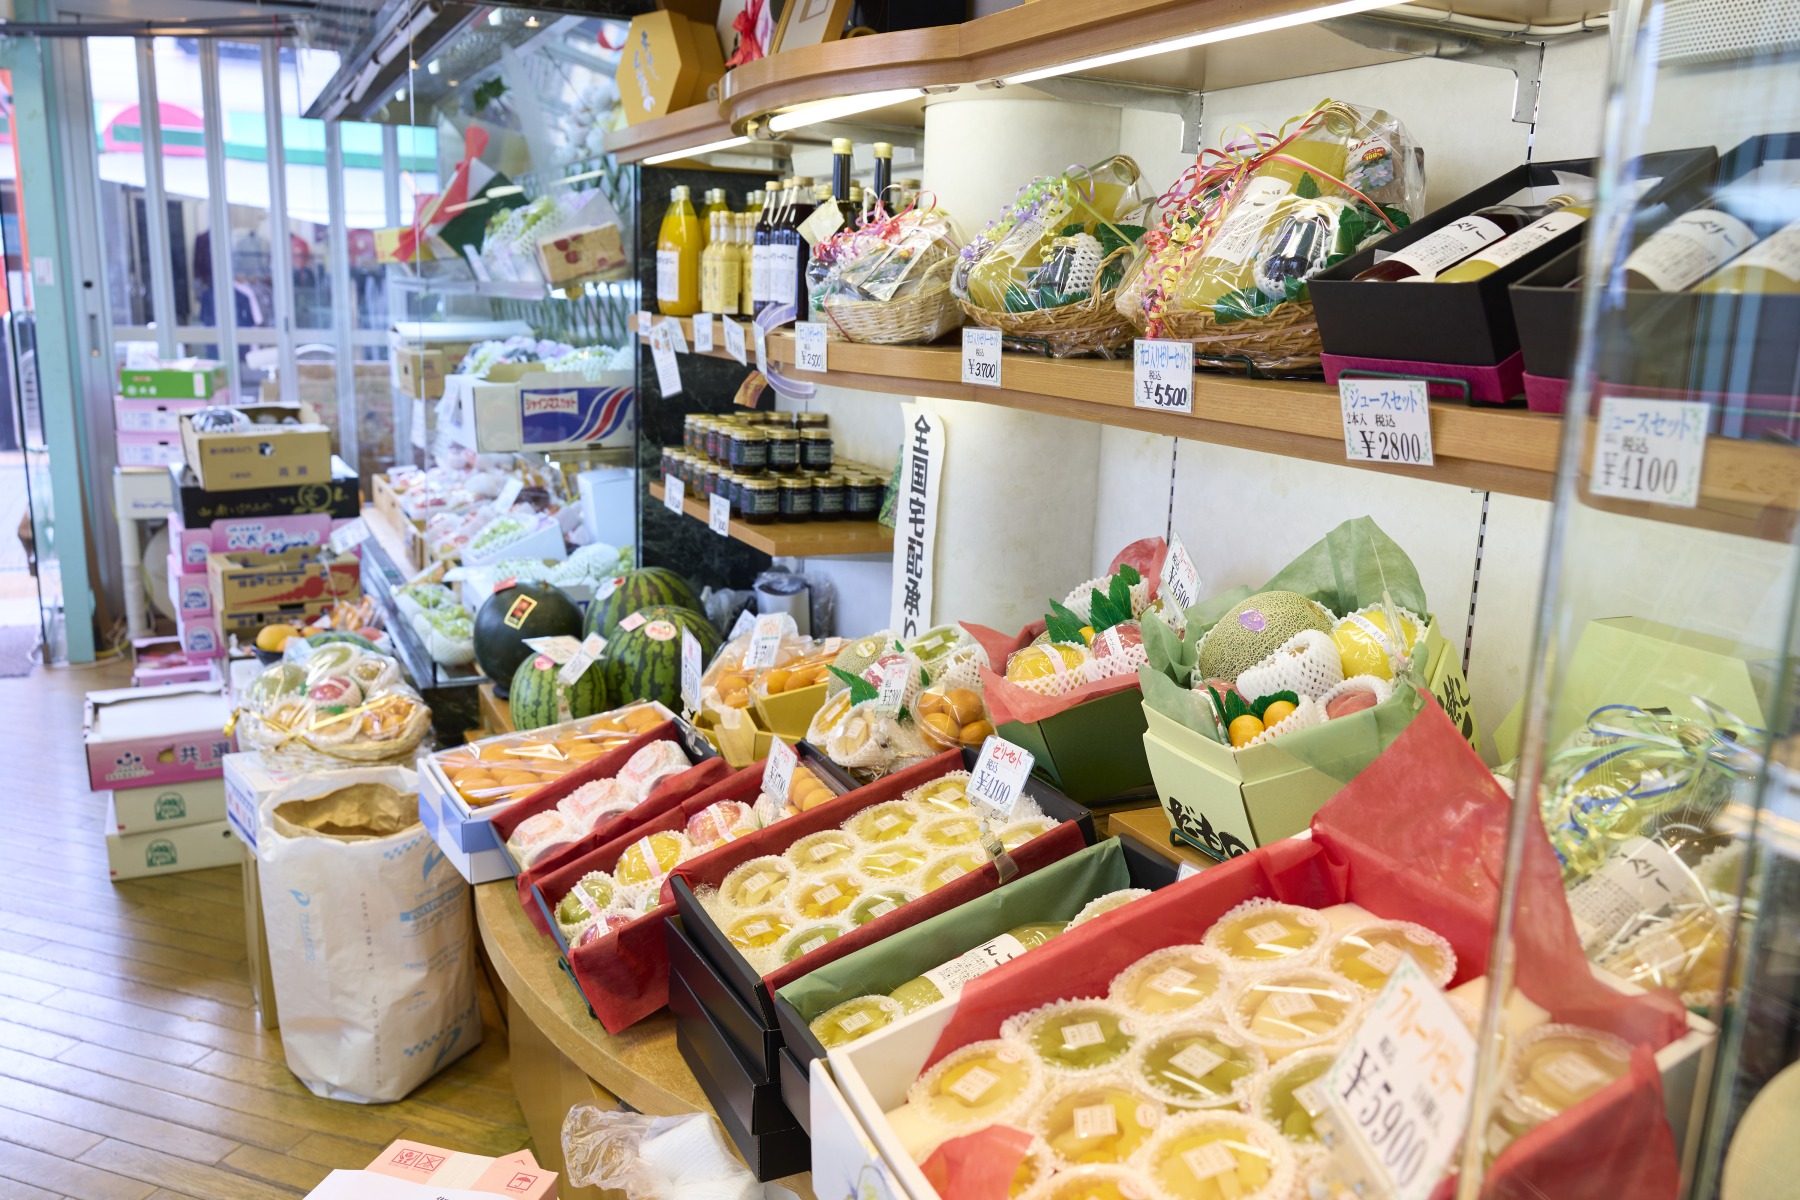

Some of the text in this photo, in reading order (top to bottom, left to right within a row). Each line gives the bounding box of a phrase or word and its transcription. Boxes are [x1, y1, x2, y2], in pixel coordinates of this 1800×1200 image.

[1148, 369, 1162, 381] 税込
[1349, 388, 1418, 414] ジュースセット
[1346, 411, 1396, 428] 2本入 税込
[1358, 430, 1421, 463] ¥2800
[975, 769, 1011, 804] ¥4100
[1342, 1048, 1428, 1189] ¥5900
